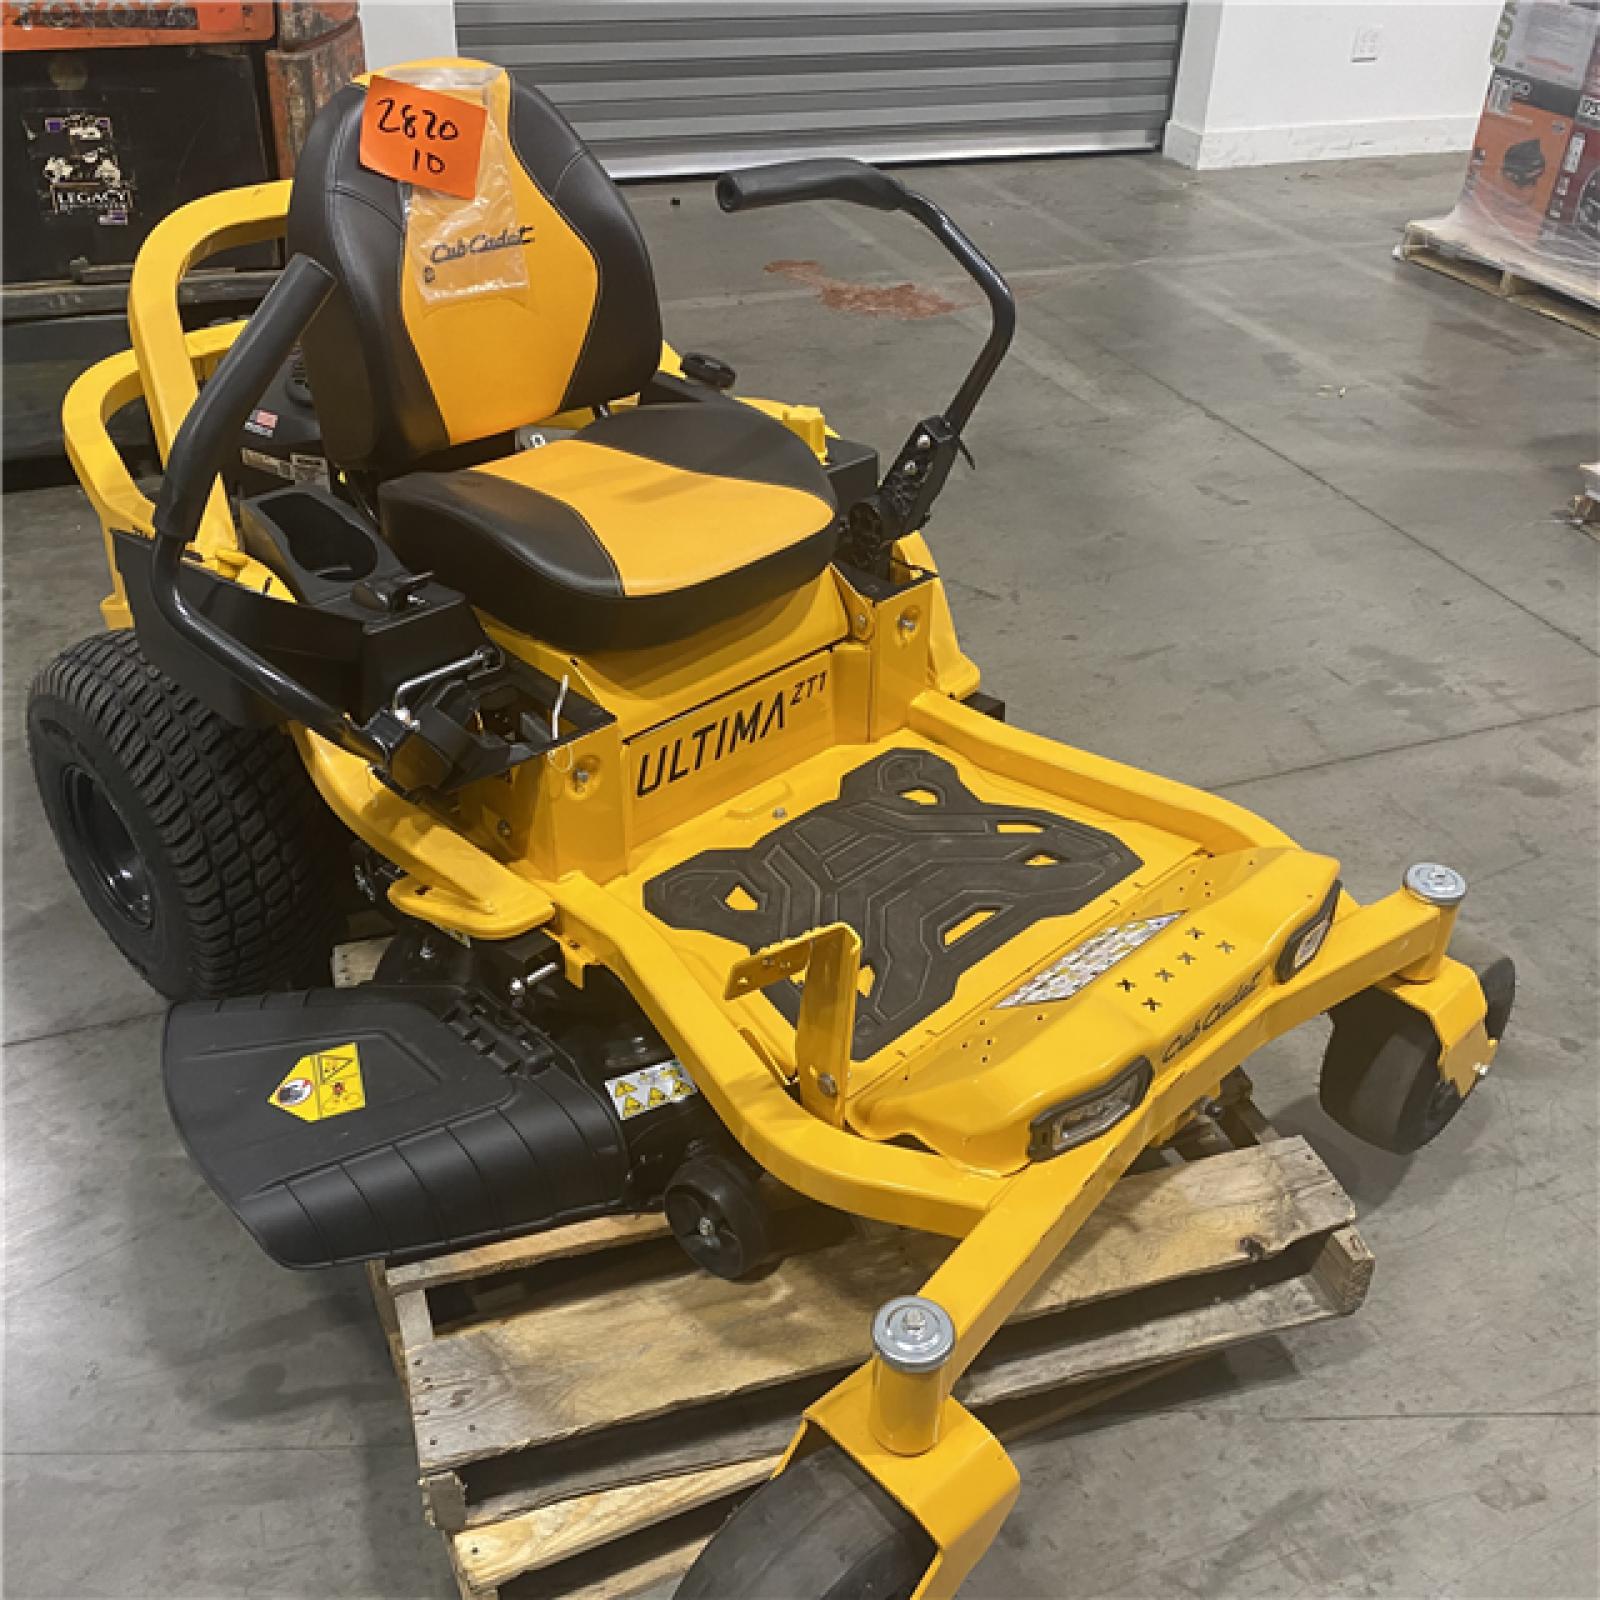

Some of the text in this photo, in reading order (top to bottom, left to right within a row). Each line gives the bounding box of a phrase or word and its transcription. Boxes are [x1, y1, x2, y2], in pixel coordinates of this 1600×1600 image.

[376, 97, 459, 141] 2820
[412, 149, 446, 174] 10
[430, 239, 466, 264] Cub
[636, 671, 828, 798] ULTIMA ZT1
[1161, 1018, 1202, 1064] Cub
